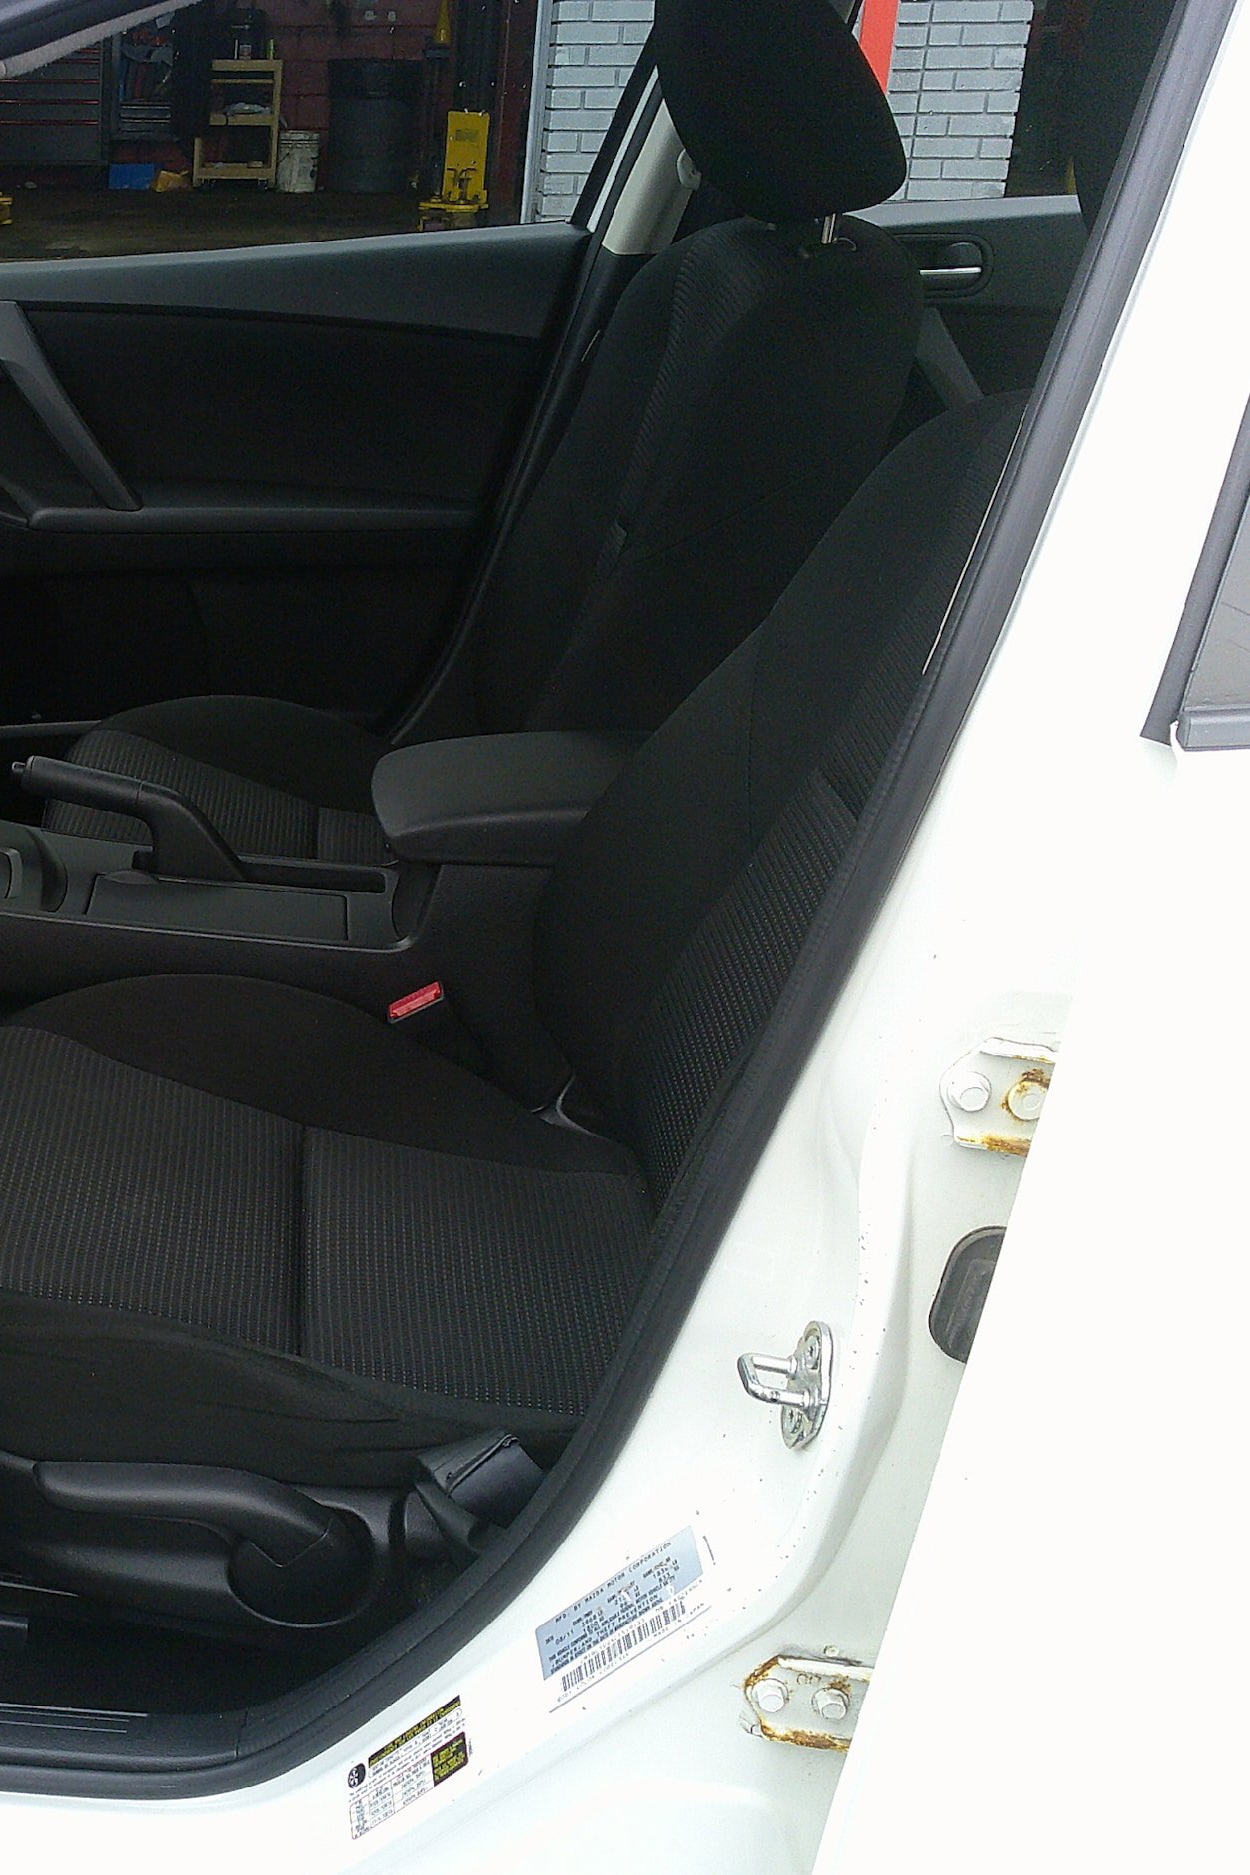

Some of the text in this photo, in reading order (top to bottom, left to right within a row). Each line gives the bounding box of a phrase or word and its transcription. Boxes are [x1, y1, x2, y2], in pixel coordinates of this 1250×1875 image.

[573, 1602, 581, 1611] BY
[585, 1587, 604, 1603] MAZDA
[607, 1572, 625, 1588] MOTOR
[628, 1540, 671, 1573] CORPORATION
[596, 1620, 615, 1637] THEFT
[617, 1591, 658, 1623] PREVENTION
